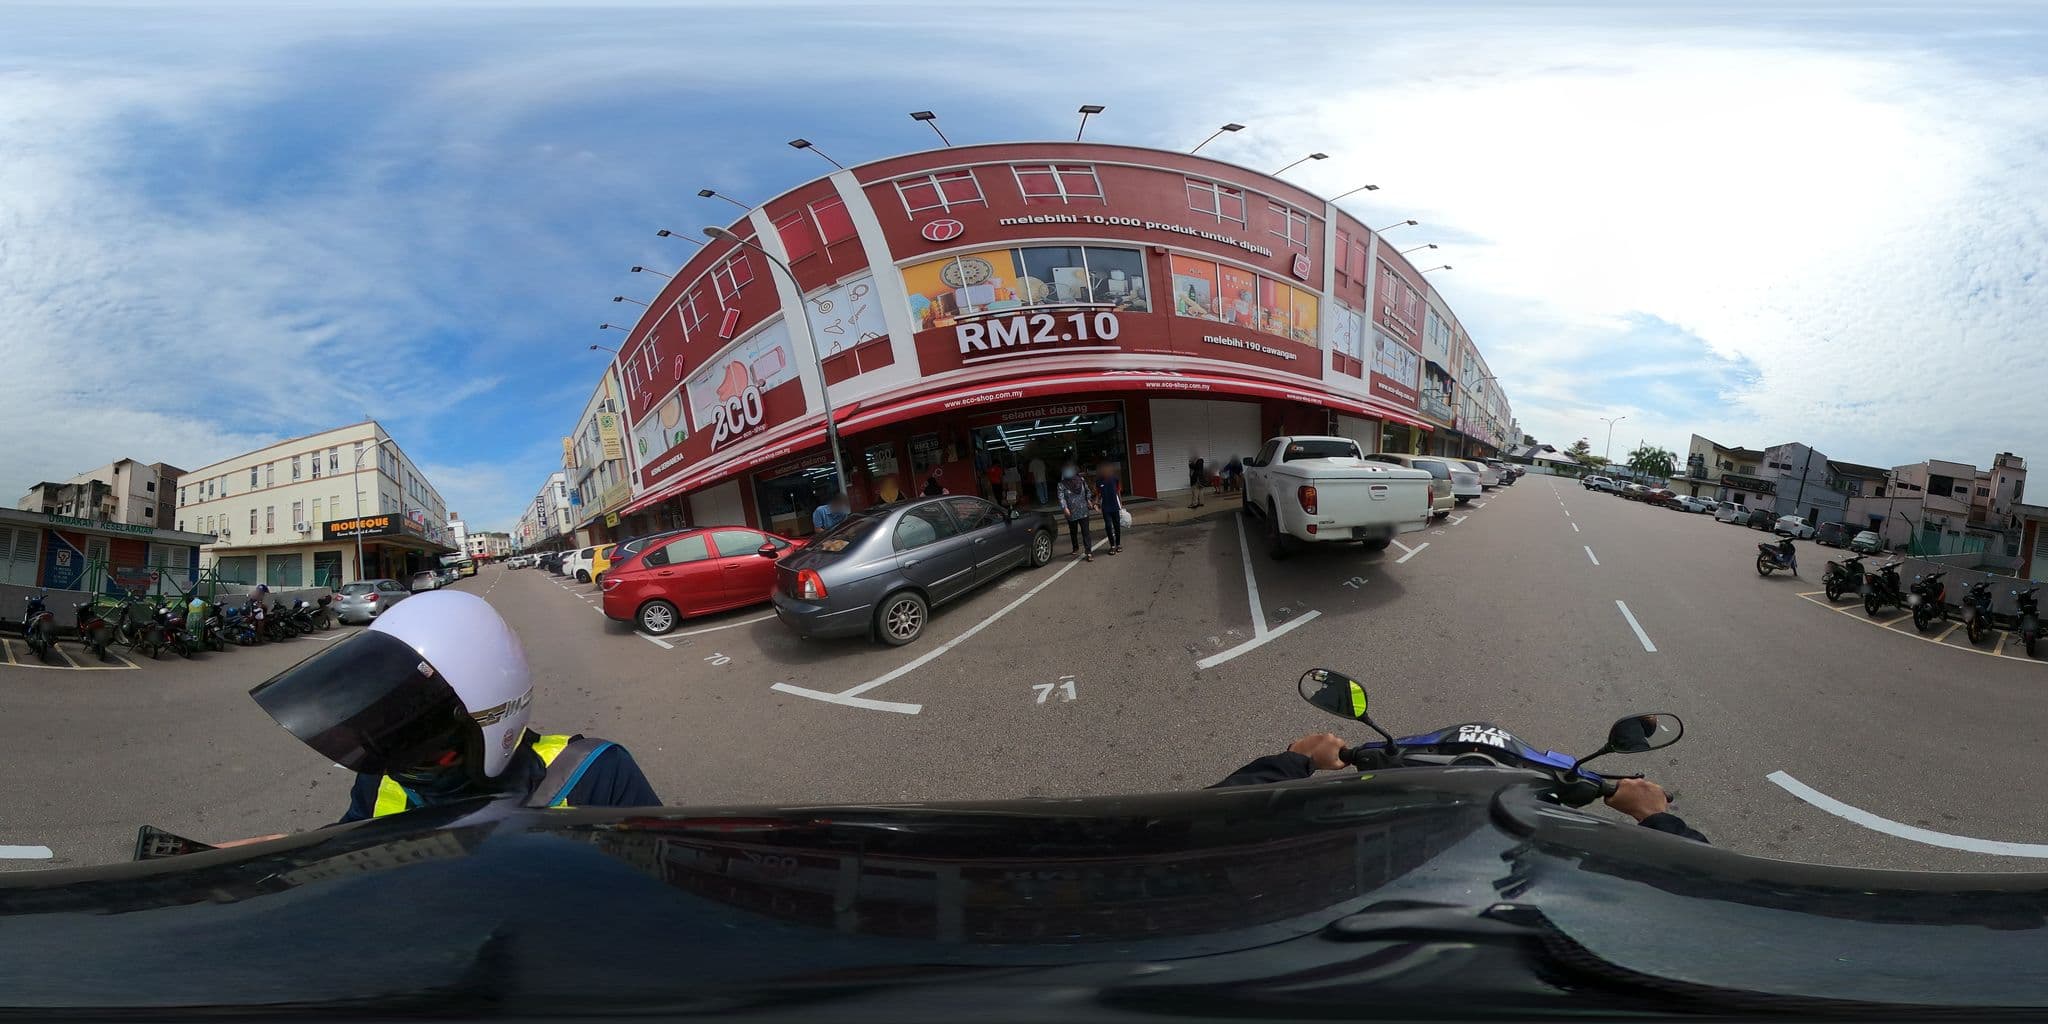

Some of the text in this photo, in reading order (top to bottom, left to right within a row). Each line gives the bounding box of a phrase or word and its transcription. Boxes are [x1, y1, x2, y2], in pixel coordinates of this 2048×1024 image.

[1000, 214, 1273, 257] melebihi 10,000 produk untuk dipilih
[955, 312, 1120, 354] RM2.10
[1203, 334, 1297, 361] melebihi 190 cawangan
[1144, 381, 1211, 391] www.eco-shop.com.my
[944, 390, 1023, 408] www.eco-shop.com.my
[1001, 404, 1088, 421] selamat datang
[100, 521, 154, 536] KESELAMATAN
[330, 517, 390, 532] MOUEQUE
[1342, 576, 1369, 589] 72
[703, 652, 731, 666] 70
[1032, 680, 1077, 704] 71
[1459, 732, 1505, 748] WYM
